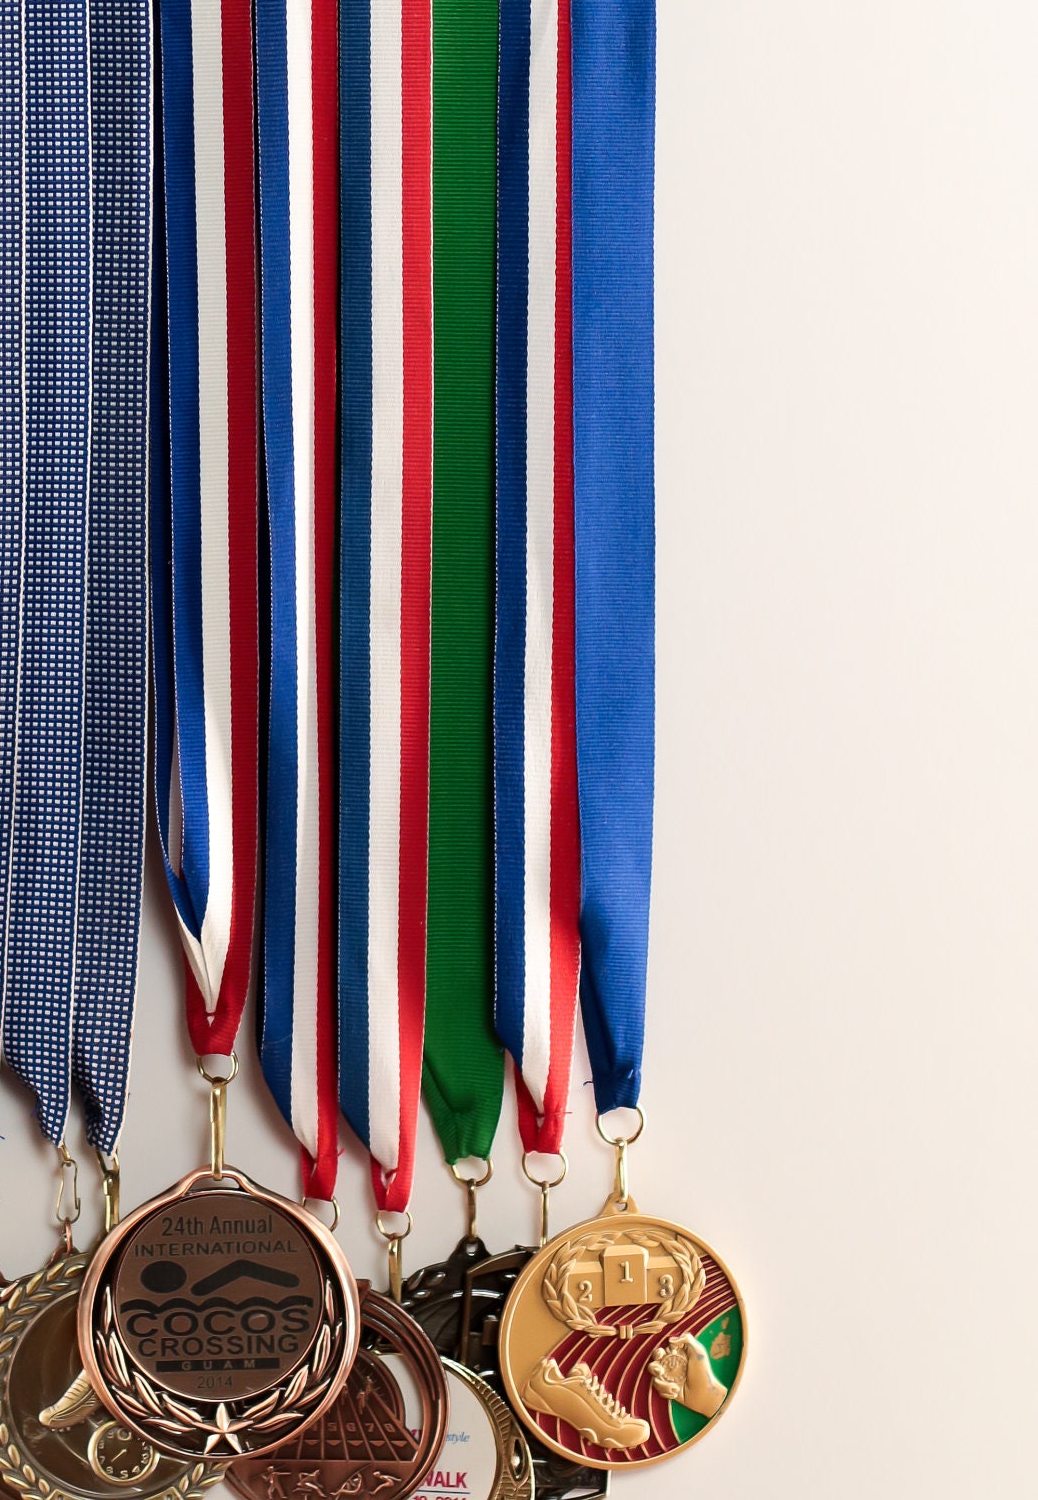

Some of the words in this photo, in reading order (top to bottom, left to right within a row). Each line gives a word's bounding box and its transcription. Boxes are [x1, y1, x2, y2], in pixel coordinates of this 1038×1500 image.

[162, 1216, 203, 1237] 24th
[210, 1214, 273, 1235] Annual
[134, 1240, 298, 1257] INTERNATIONAL
[578, 1280, 593, 1302] 2
[619, 1261, 634, 1283] 1
[659, 1274, 674, 1298] 3
[126, 1308, 311, 1337] COCOS
[138, 1334, 299, 1358] CROSSING
[180, 1360, 256, 1371] GUAM
[197, 1376, 234, 1390] 2014
[445, 1431, 470, 1444] style
